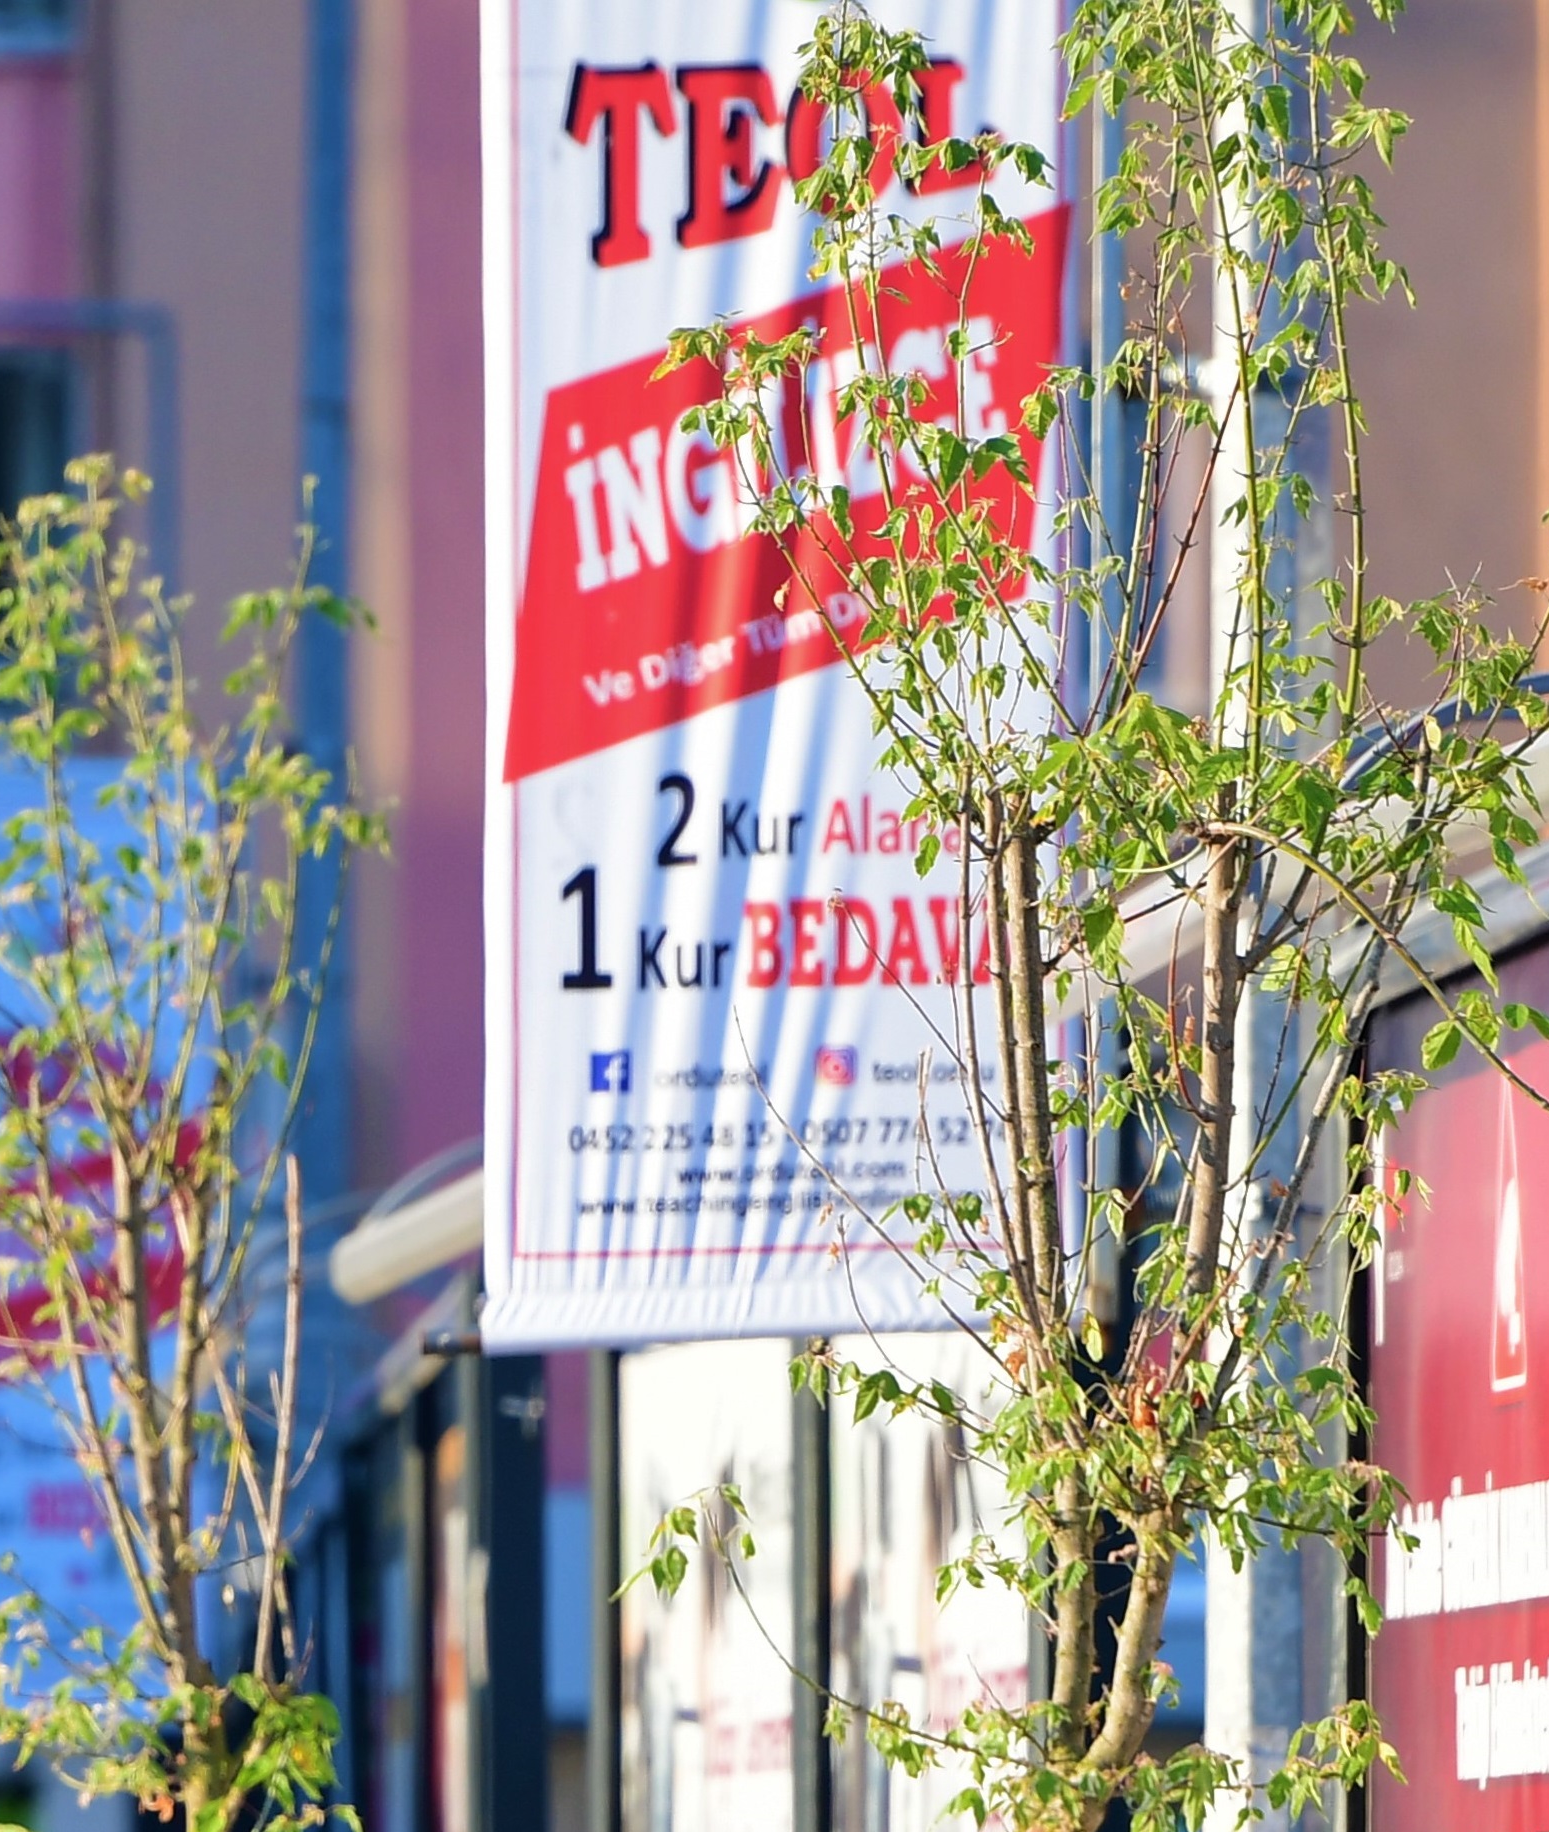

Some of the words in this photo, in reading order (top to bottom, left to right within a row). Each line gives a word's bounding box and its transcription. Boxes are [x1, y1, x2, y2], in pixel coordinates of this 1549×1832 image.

[583, 670, 636, 706] Ve
[655, 773, 698, 867] 2
[720, 800, 805, 859] Kur
[561, 866, 613, 991] 1
[638, 928, 731, 991] Kur
